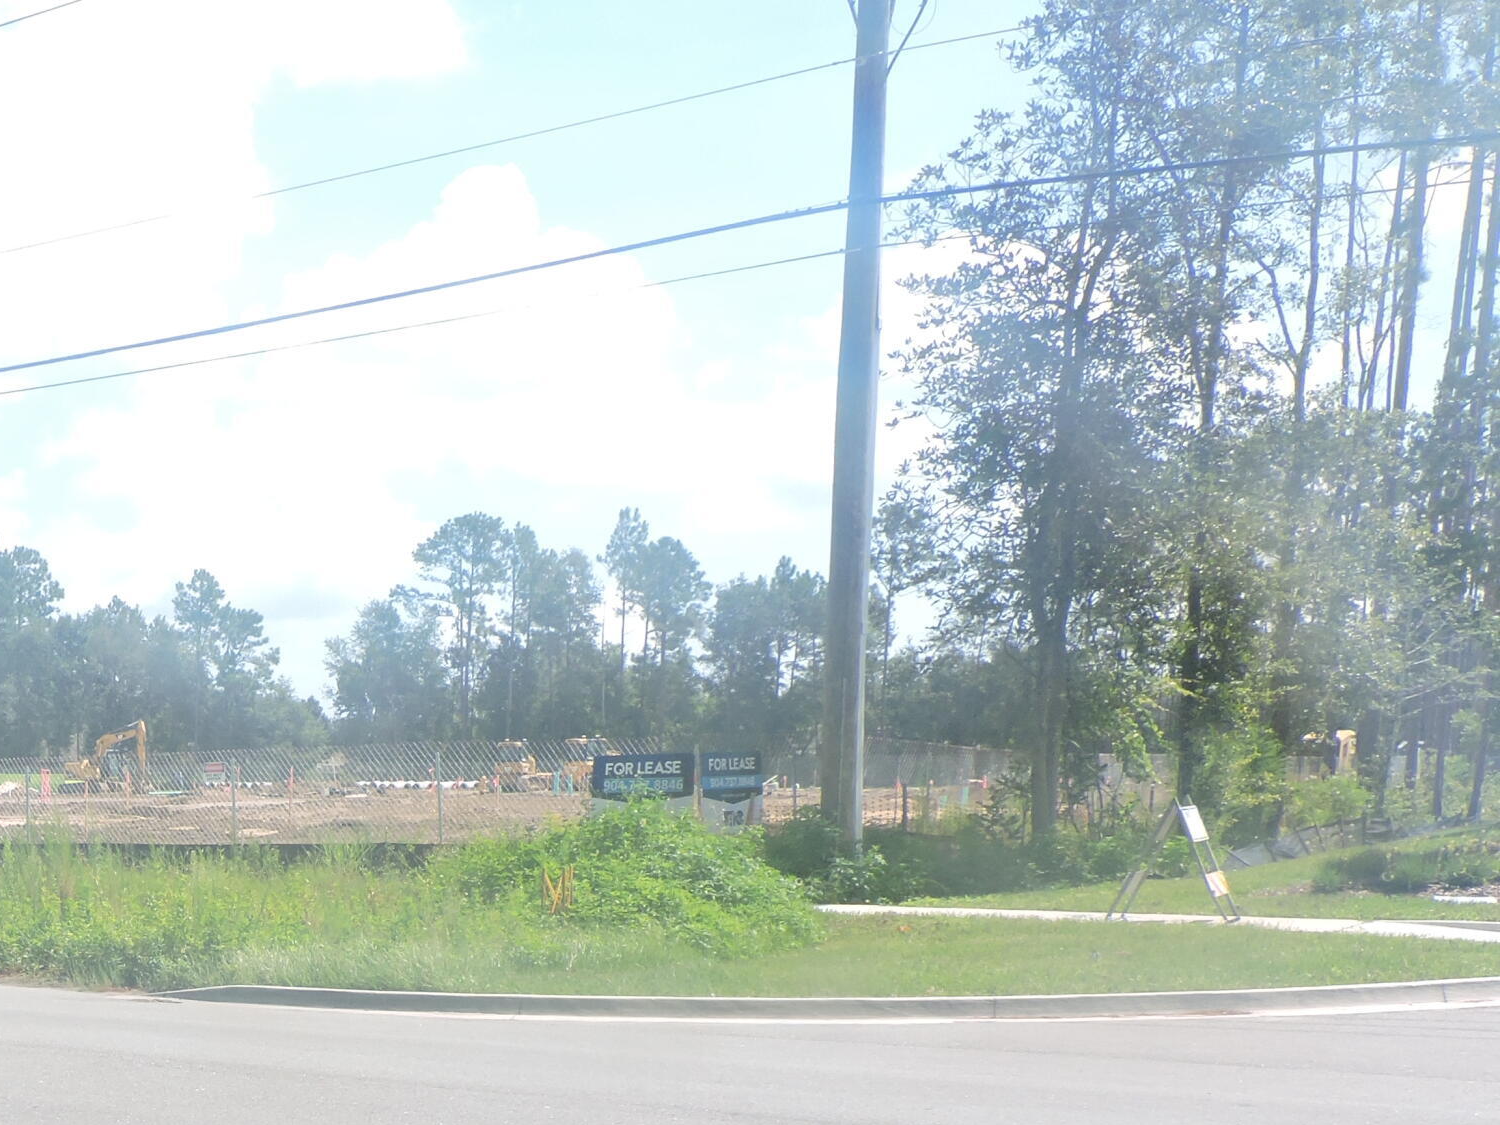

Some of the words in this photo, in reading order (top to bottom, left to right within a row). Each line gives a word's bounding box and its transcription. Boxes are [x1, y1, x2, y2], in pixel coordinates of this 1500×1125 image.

[605, 762, 634, 776] FOR
[637, 760, 682, 775] LEASE
[708, 758, 727, 771] FOR
[728, 757, 756, 770] LEASE
